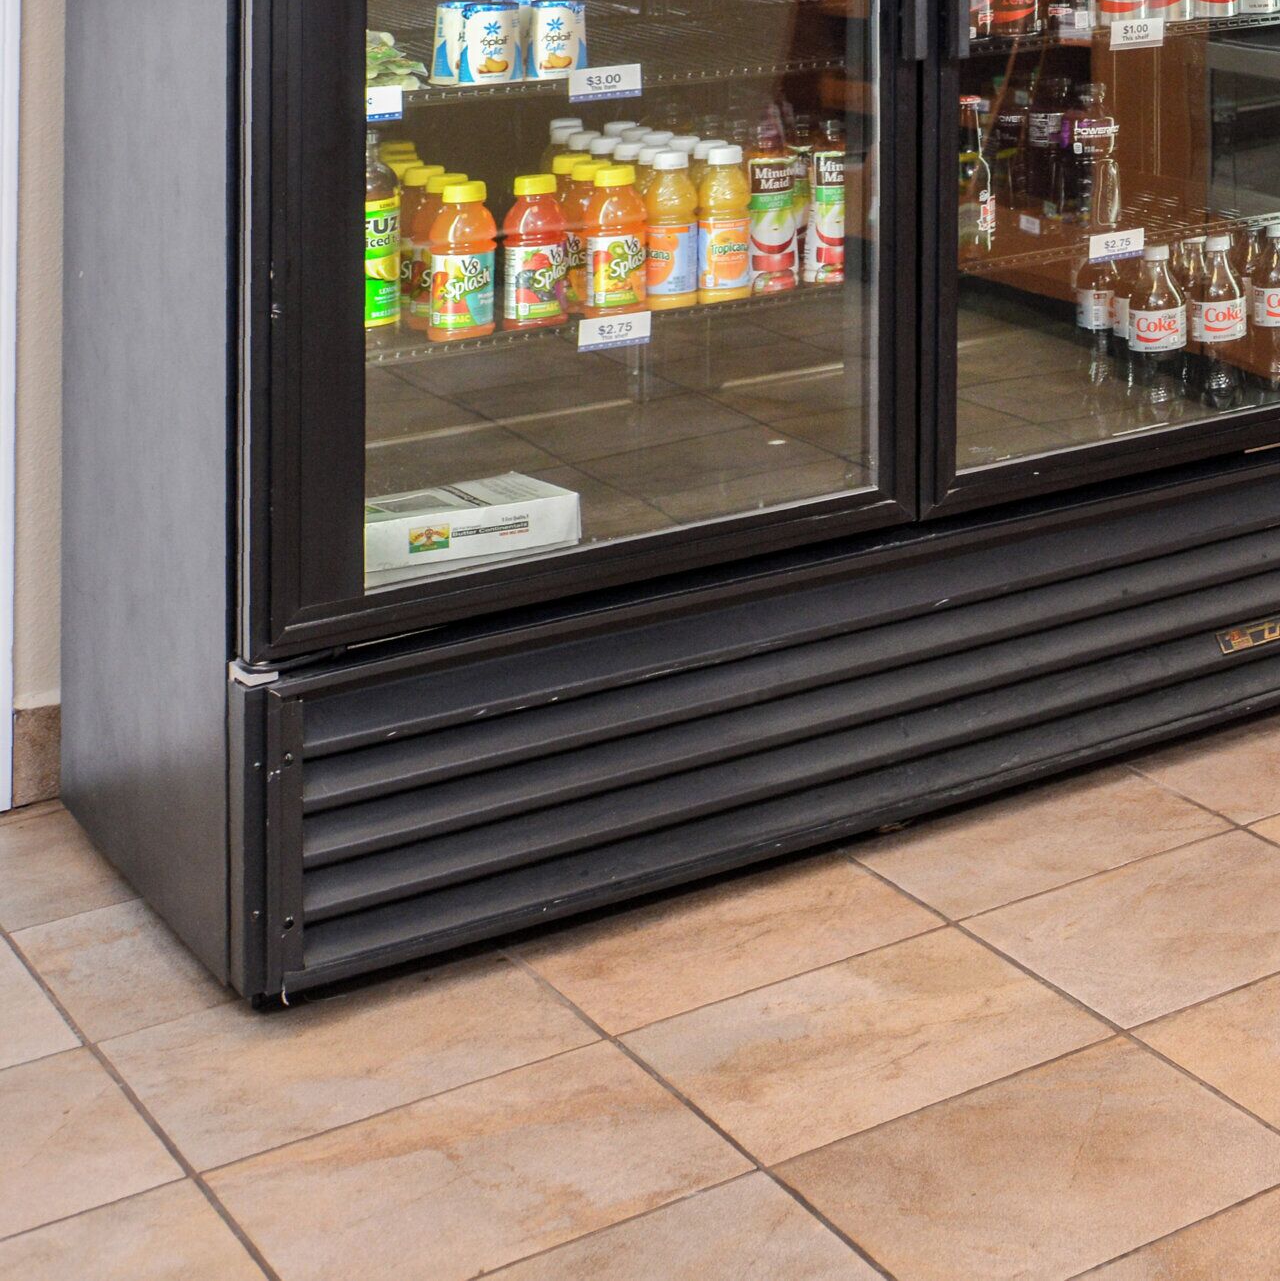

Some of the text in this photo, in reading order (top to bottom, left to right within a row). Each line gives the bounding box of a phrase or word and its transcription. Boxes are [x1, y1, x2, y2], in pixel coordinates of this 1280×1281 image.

[1122, 23, 1149, 35] $1.00
[1122, 33, 1150, 42] This shelf
[586, 74, 622, 86] $3.00
[760, 176, 790, 190] Maid
[623, 236, 639, 252] V8
[1104, 237, 1131, 249] $2.75
[549, 246, 566, 266] V8
[461, 256, 481, 276] V8
[444, 267, 492, 299] Splash
[1204, 306, 1242, 324] Coke
[598, 321, 633, 336] $2.75
[1135, 317, 1178, 333] Coke
